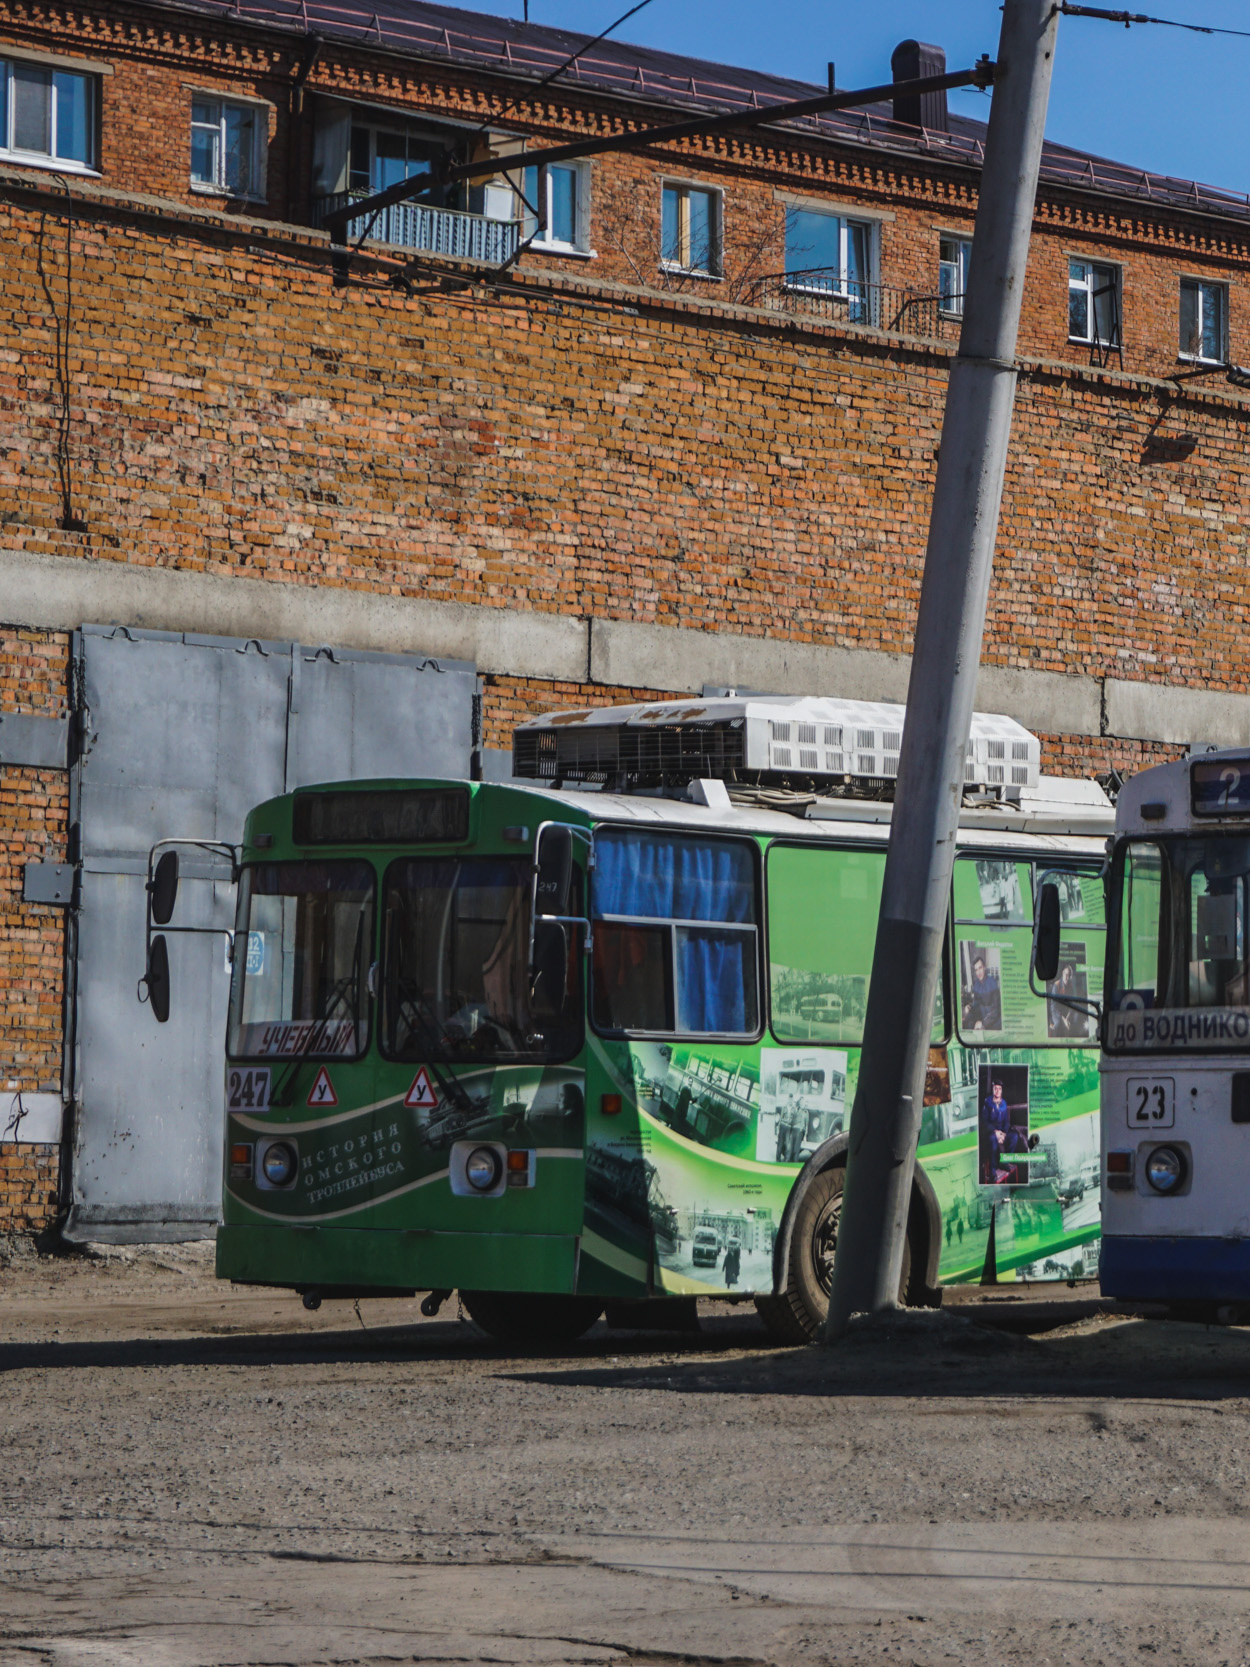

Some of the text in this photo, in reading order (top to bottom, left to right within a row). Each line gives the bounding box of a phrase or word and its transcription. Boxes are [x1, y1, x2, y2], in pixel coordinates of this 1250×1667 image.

[1218, 767, 1241, 806] 2
[539, 881, 558, 892] 247
[1114, 1023, 1137, 1047] до
[229, 1070, 269, 1108] 247
[1136, 1085, 1166, 1121] 23
[302, 1122, 399, 1169] ИСТОРИЯ
[304, 1141, 401, 1186] ОМСКОГО
[307, 1160, 405, 1204] ТРОЛЛЕЙБУСА
